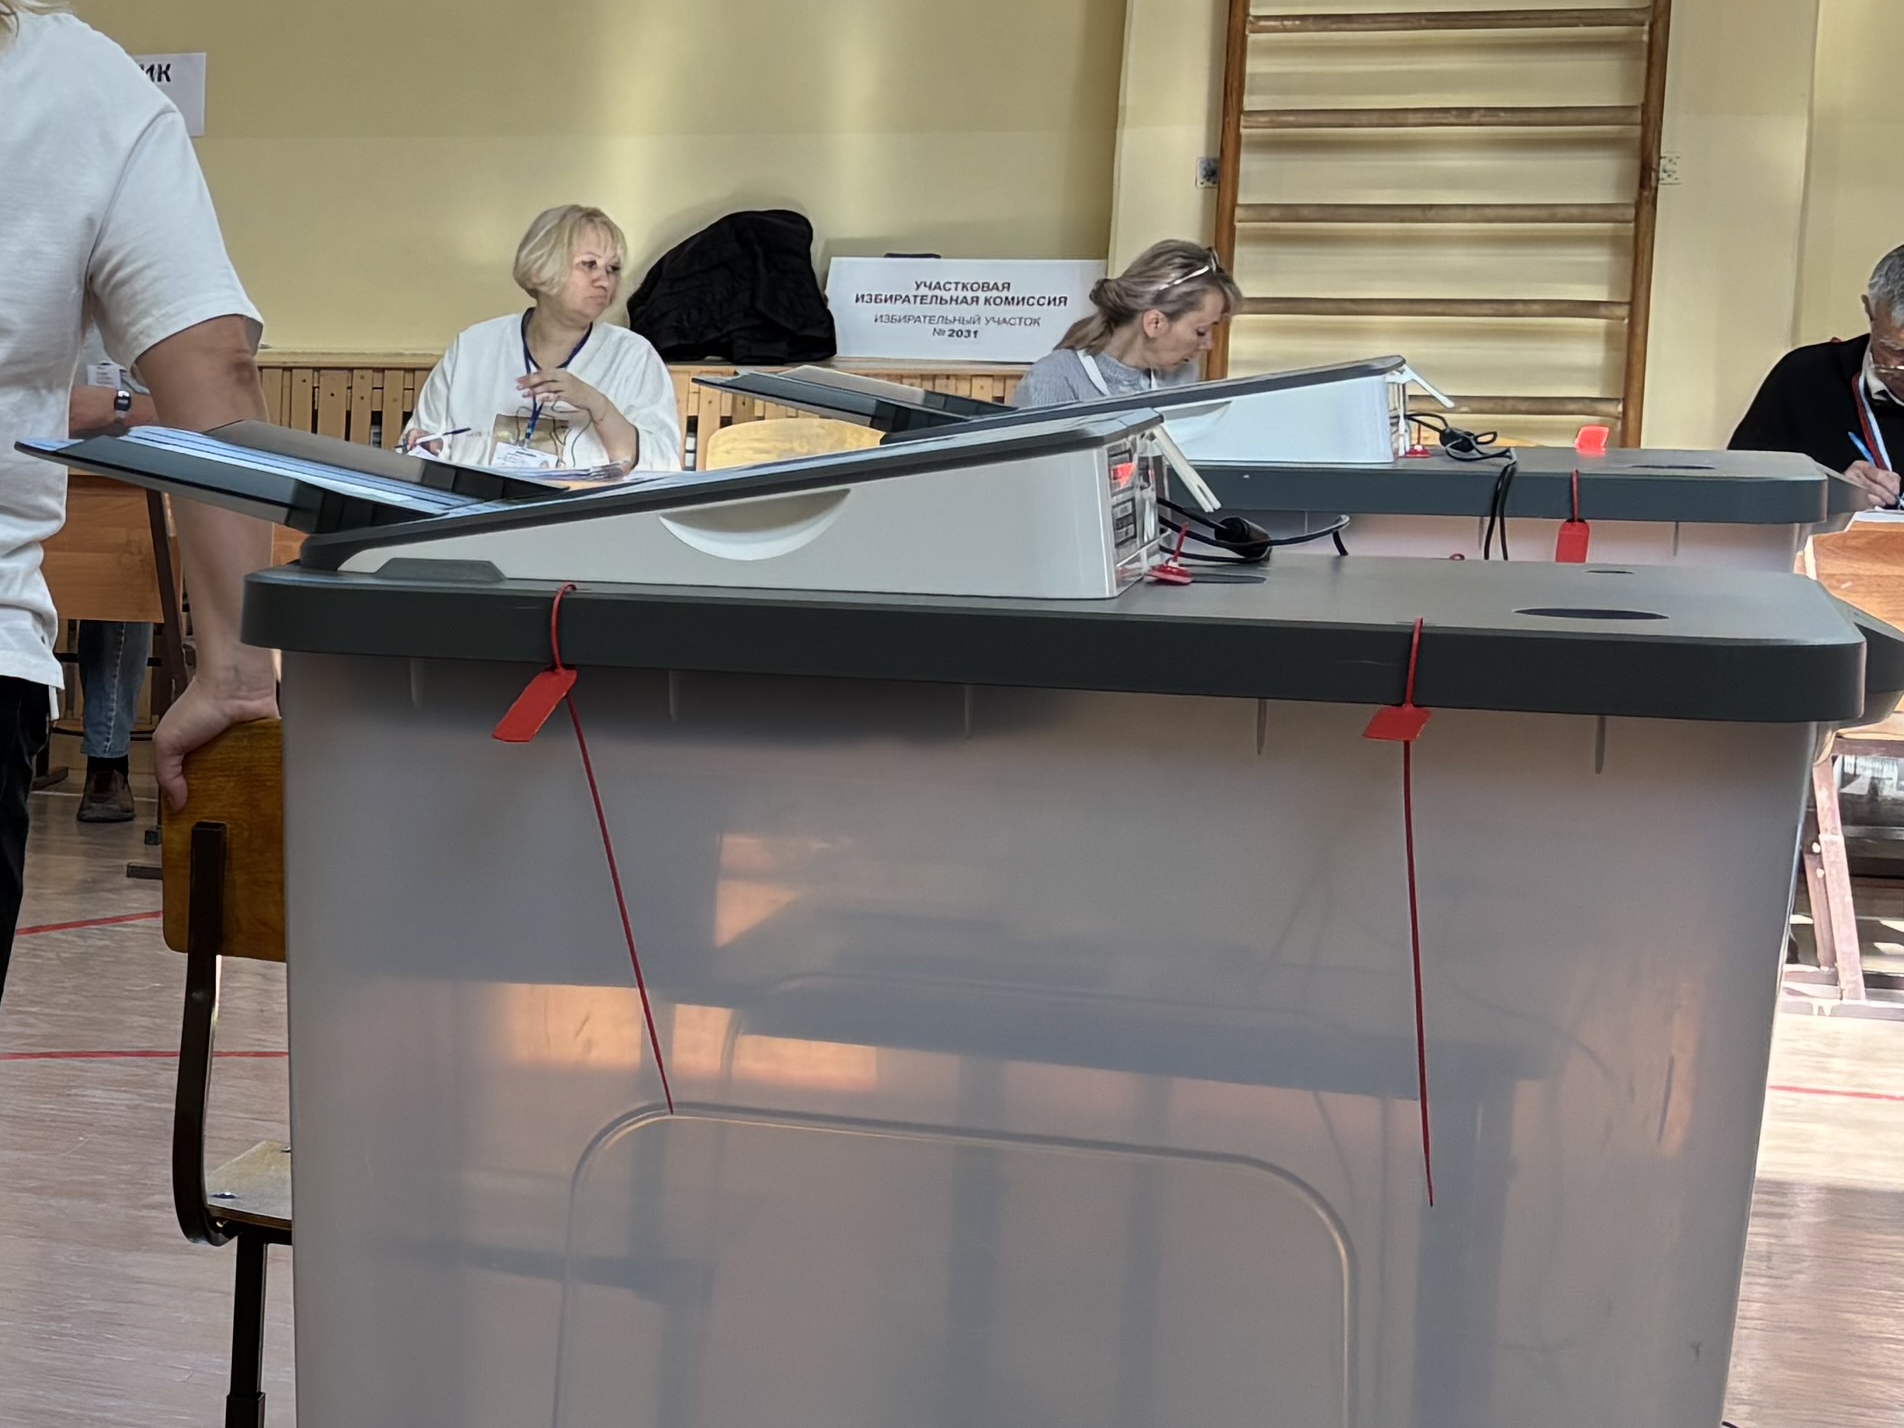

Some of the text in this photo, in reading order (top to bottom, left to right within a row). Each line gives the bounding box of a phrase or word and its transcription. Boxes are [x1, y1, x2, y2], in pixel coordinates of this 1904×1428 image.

[138, 63, 172, 83] ИК
[914, 280, 1011, 293] УЧАСТКОВАЯ
[855, 293, 1068, 307] ИЗБИРАТЕЛЬНАЯ КОМИССИЯ
[874, 314, 1041, 327] ИЗБИРАТЕЛЬНЫЙ УЧАСТОК
[947, 328, 979, 339] 2031
